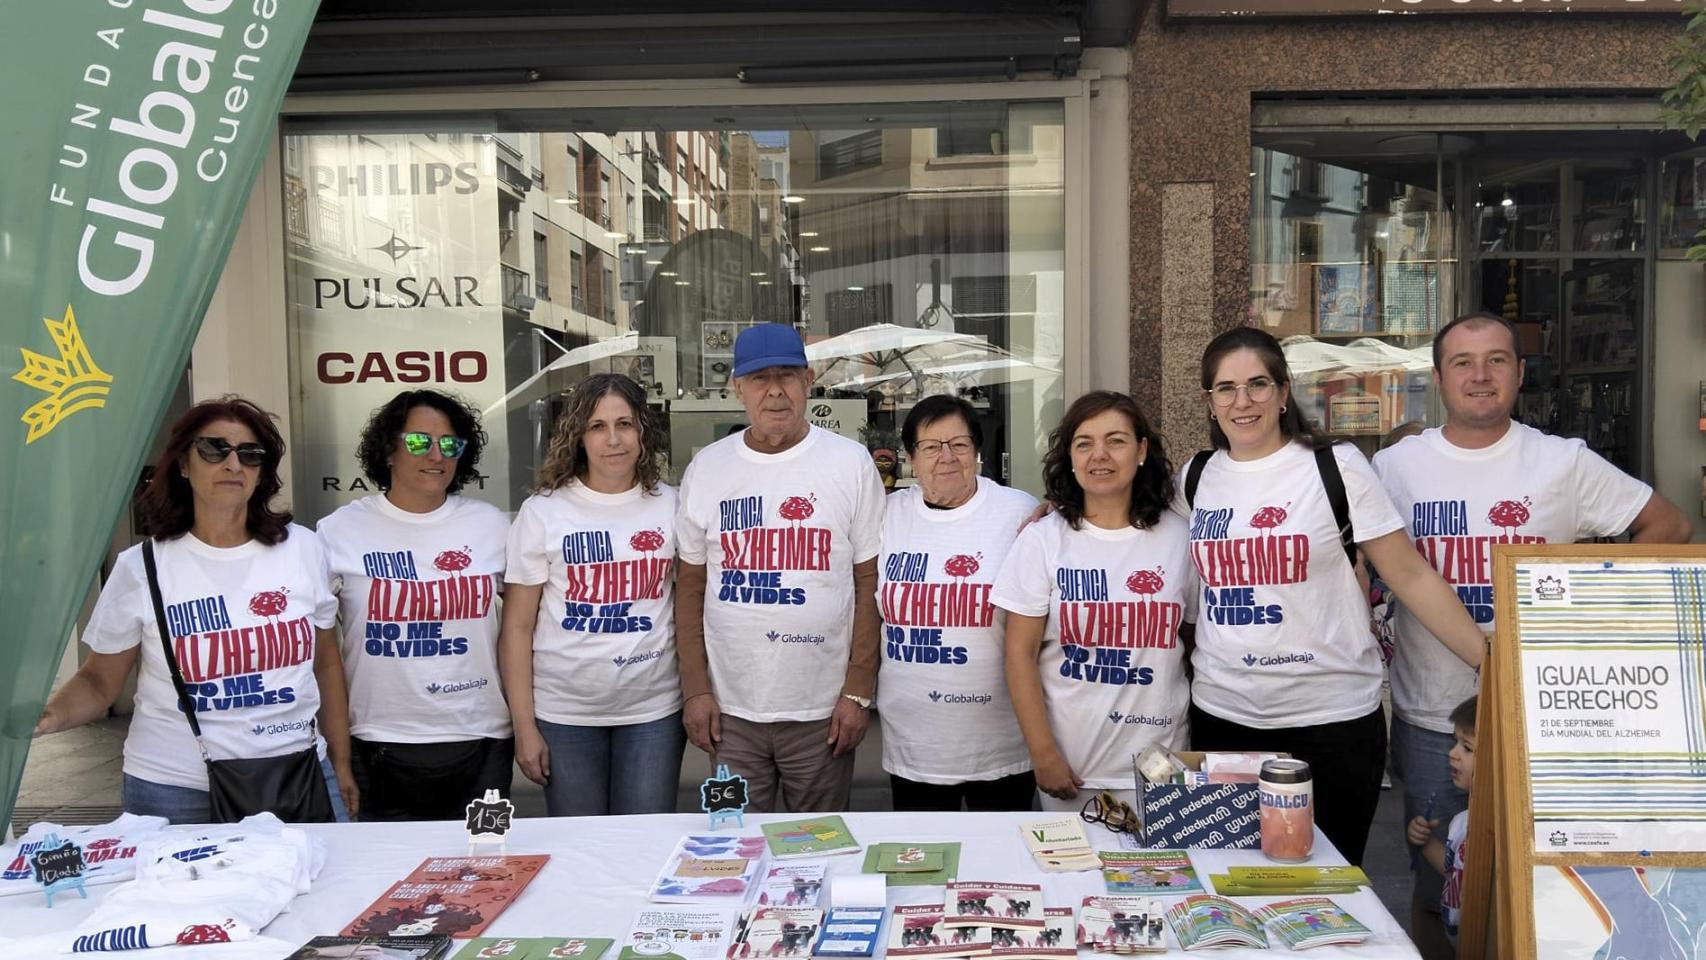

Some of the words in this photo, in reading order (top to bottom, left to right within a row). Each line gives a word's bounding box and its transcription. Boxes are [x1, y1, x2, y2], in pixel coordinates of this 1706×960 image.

[196, 0, 278, 182] Cuenca
[77, 0, 233, 296] Global
[309, 162, 479, 196] PHILIPS
[313, 276, 483, 309] PULSAR
[317, 351, 488, 384] CASIO
[720, 496, 763, 532] CUENCA
[1413, 500, 1468, 537] CUENCA
[562, 530, 614, 565] CUENCA
[720, 527, 832, 571] ALZHEIMER
[363, 550, 418, 580] CUENCA
[885, 551, 929, 582] CUENCA
[1190, 534, 1310, 587] LZHEIMER
[721, 570, 745, 586] NO
[750, 572, 782, 588] ME
[1057, 568, 1108, 601] CUENCA
[367, 574, 493, 622] ALZHEIMER
[718, 585, 806, 605] OLVIDES
[881, 582, 997, 628] ALZHEIMER
[1220, 587, 1256, 606] ME
[166, 595, 232, 638] CUENCA
[565, 602, 593, 618] NO
[599, 602, 633, 617] ME
[365, 622, 400, 641] NO
[407, 622, 443, 640] ME
[561, 616, 653, 633] OLVIDES
[886, 625, 905, 644] NO
[910, 628, 942, 646] ME
[1059, 600, 1182, 649] ALZHEIMER
[174, 616, 312, 683] ALZHEIMER
[365, 637, 468, 658] OLVIDES
[781, 633, 825, 646] Globalcaja
[887, 642, 968, 665] OLVIDES
[1062, 644, 1090, 664] NO
[1095, 647, 1131, 667] ME
[1260, 652, 1315, 666] Globalcaja
[1059, 659, 1154, 685] OLVIDES
[1537, 665, 1669, 686] IGUALANDO
[223, 673, 265, 696] ME
[443, 678, 488, 693] Globalcaja
[177, 686, 296, 713] OLVIDES
[944, 693, 992, 704] Globalcaja
[1538, 689, 1659, 710] DERECHOS
[1125, 715, 1172, 728] Globalcaja
[1540, 719, 1549, 727] 21
[1551, 719, 1562, 727] DE
[1564, 719, 1615, 727] SEPTIEMBRE
[1541, 728, 1554, 738] DÍA
[1556, 729, 1592, 738] MUNDIAL
[1596, 730, 1612, 738] DEL
[1615, 730, 1661, 738] ALZHEIMER
[710, 785, 736, 803] 5€
[472, 807, 511, 830] 15€
